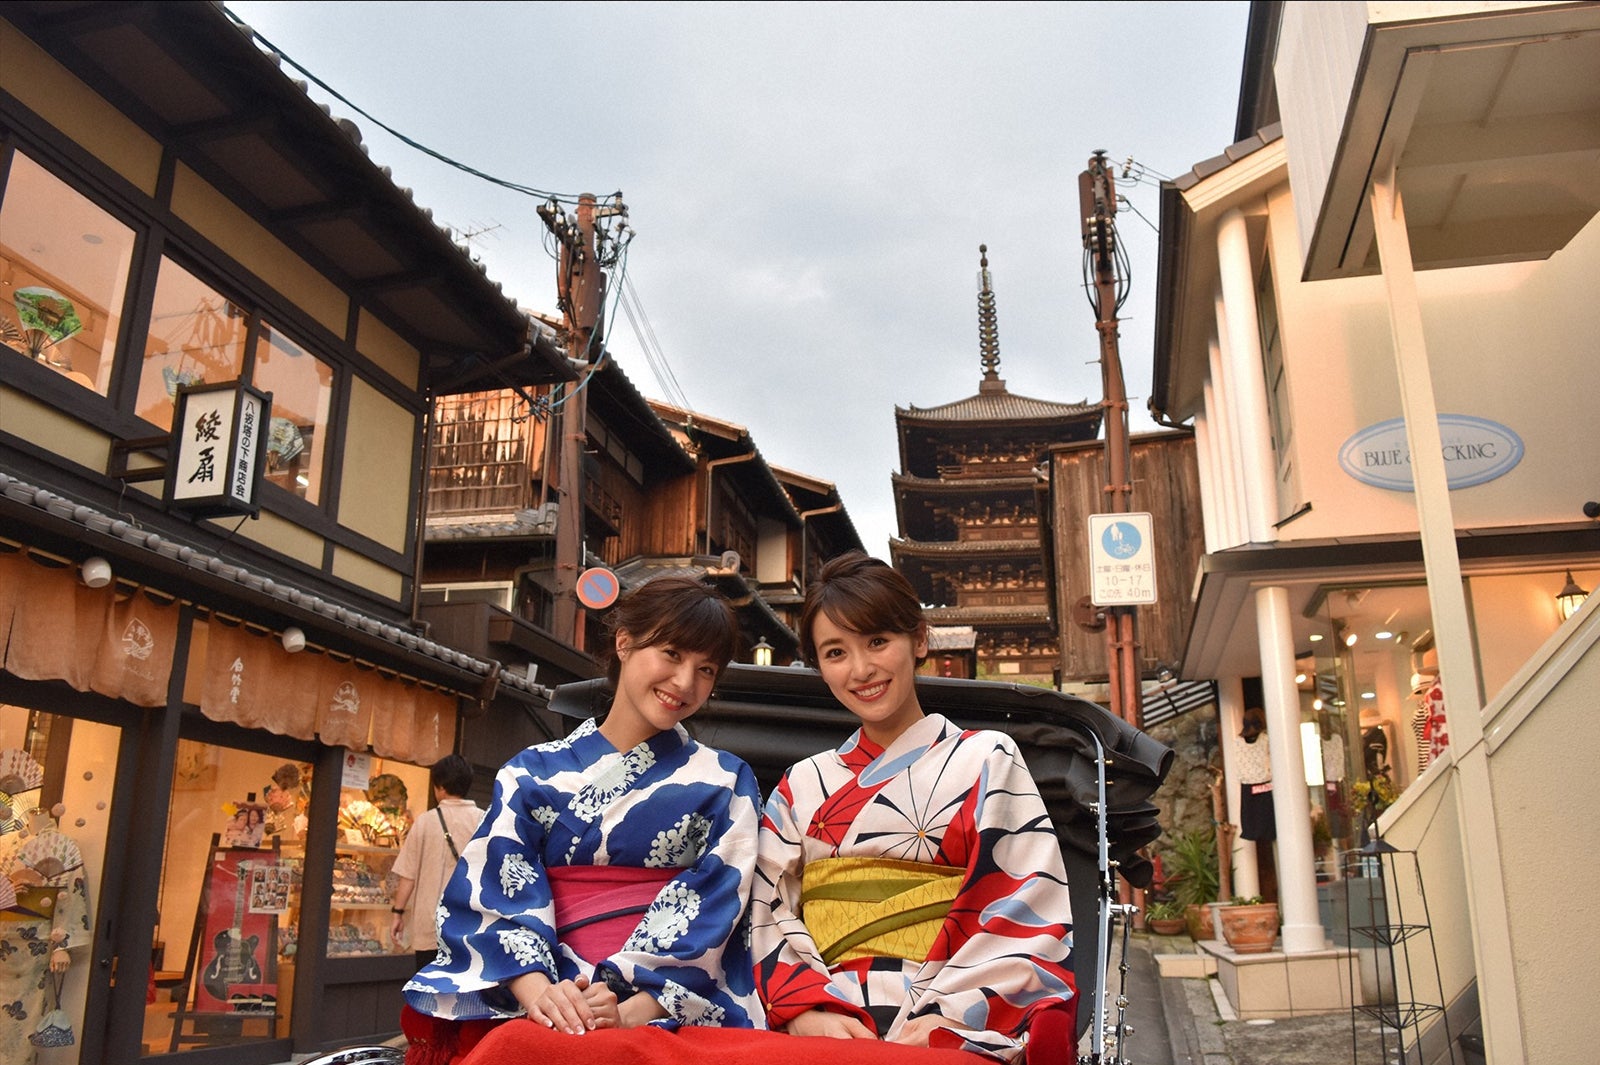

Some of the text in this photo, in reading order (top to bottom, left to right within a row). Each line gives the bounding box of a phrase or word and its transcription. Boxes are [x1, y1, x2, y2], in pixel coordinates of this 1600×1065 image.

[188, 408, 222, 484] 綾扇
[235, 400, 256, 498] 八坂塔の下商店会
[1364, 449, 1403, 467] BLUE
[1441, 442, 1497, 462] CKING
[1127, 587, 1152, 599] 40m
